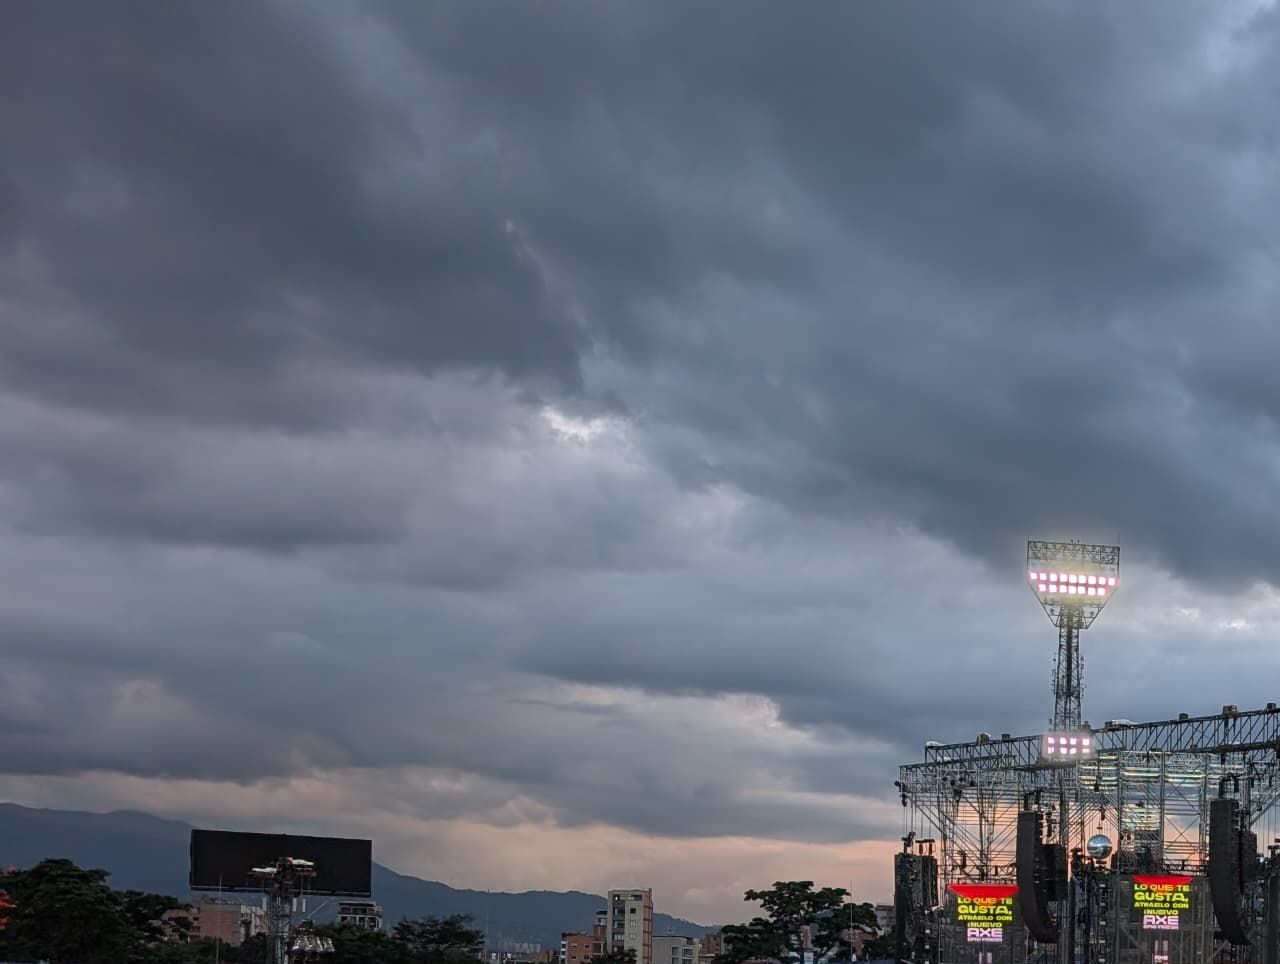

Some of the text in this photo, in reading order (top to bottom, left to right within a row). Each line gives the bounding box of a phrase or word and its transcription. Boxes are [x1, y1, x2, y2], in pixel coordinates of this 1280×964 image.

[1150, 884, 1174, 892] QUE
[1134, 892, 1189, 902] GUSTA,
[957, 905, 1012, 914] GUSTA,
[1143, 915, 1179, 925] AXE
[967, 928, 1003, 937] AXE
